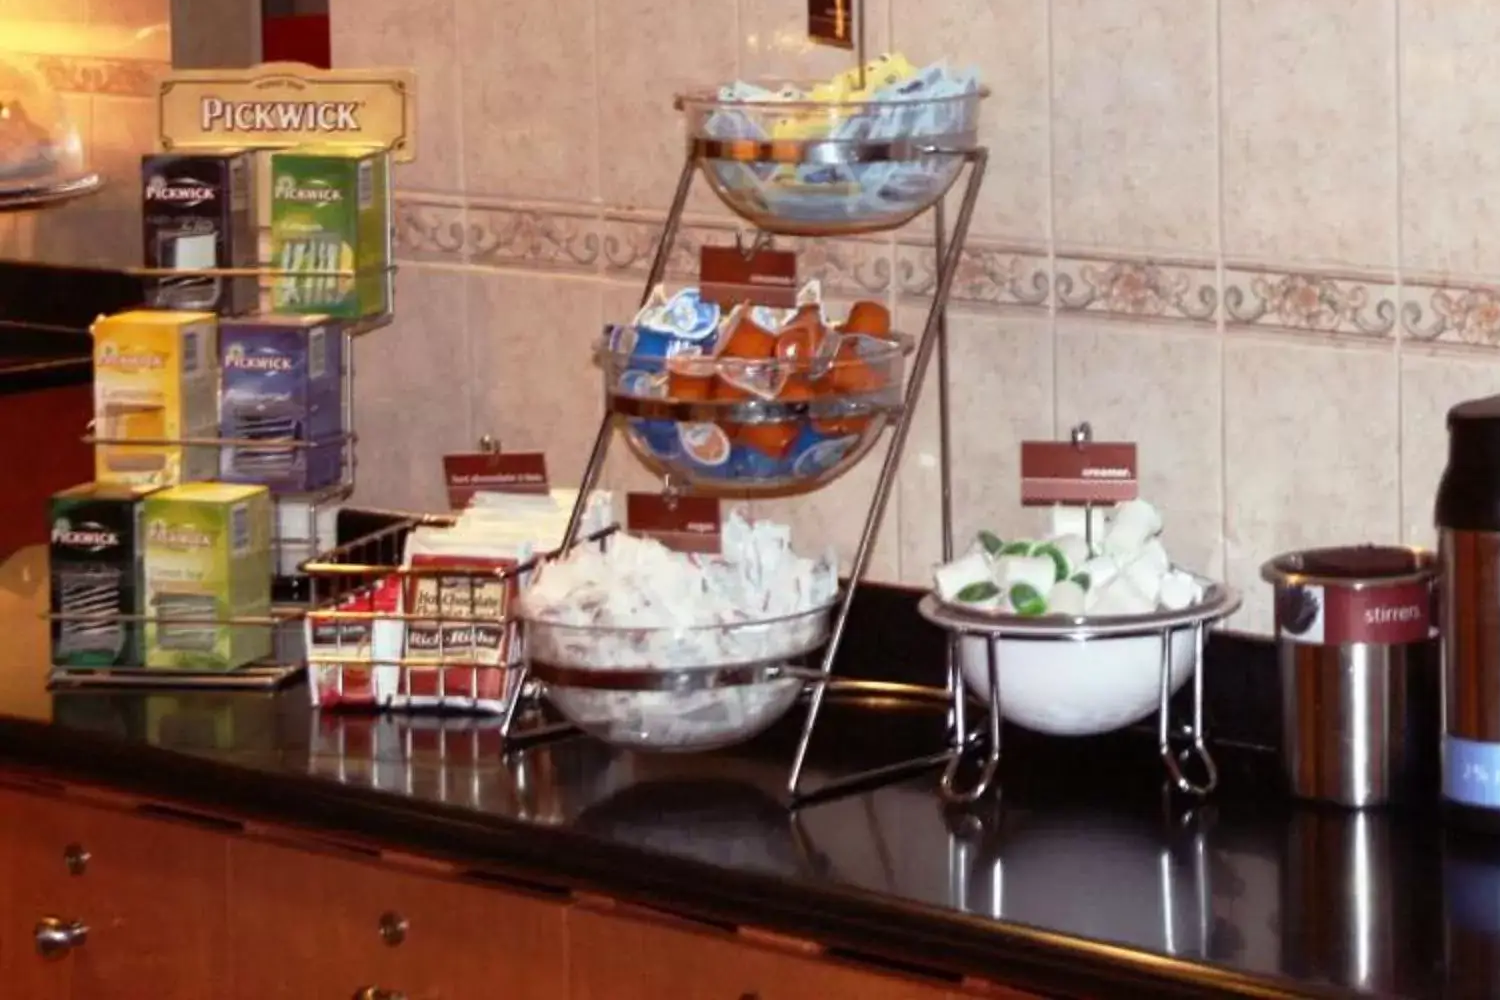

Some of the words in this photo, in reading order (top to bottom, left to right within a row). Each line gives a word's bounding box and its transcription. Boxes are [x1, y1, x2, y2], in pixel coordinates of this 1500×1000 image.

[202, 97, 362, 133] PICKWICK
[145, 184, 216, 202] PICKWICK
[224, 352, 294, 371] PICKWICK
[50, 528, 121, 546] PICKWICK
